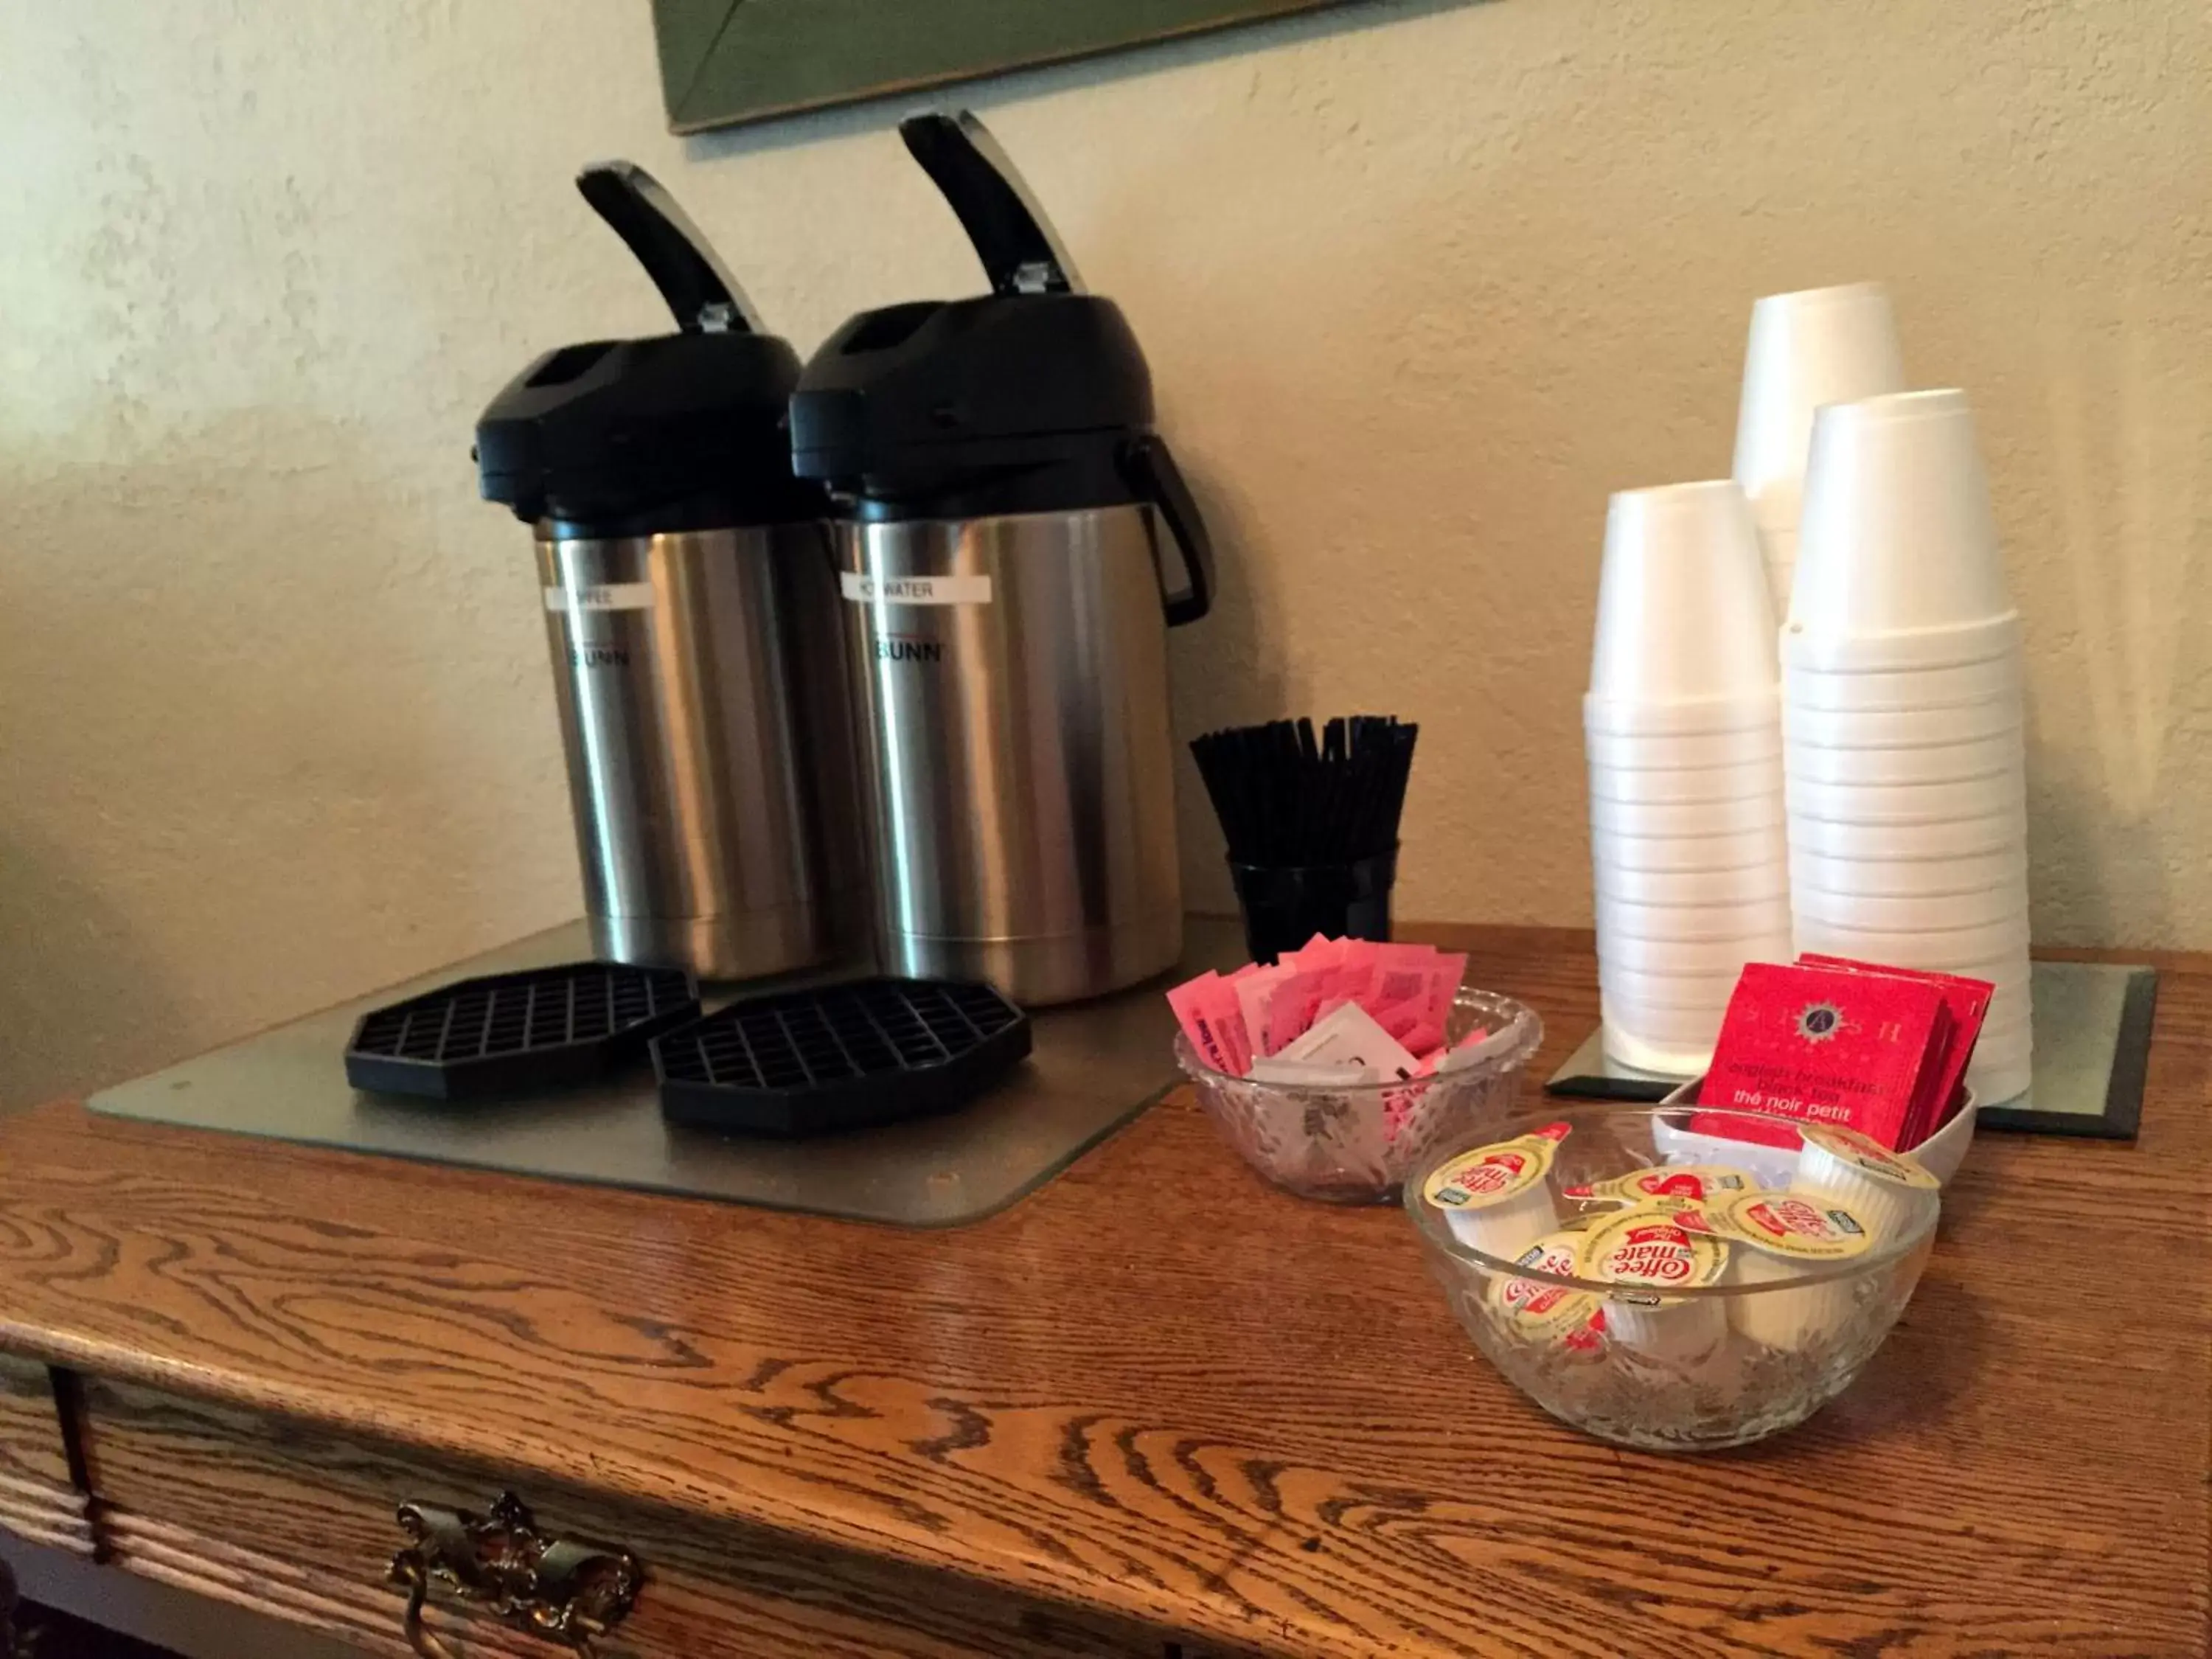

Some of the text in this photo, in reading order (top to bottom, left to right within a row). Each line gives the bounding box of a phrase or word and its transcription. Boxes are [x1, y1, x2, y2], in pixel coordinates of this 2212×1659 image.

[1767, 1096, 1804, 1111] noir
[1806, 1102, 1852, 1122] petit
[1613, 1245, 1677, 1262] mate
